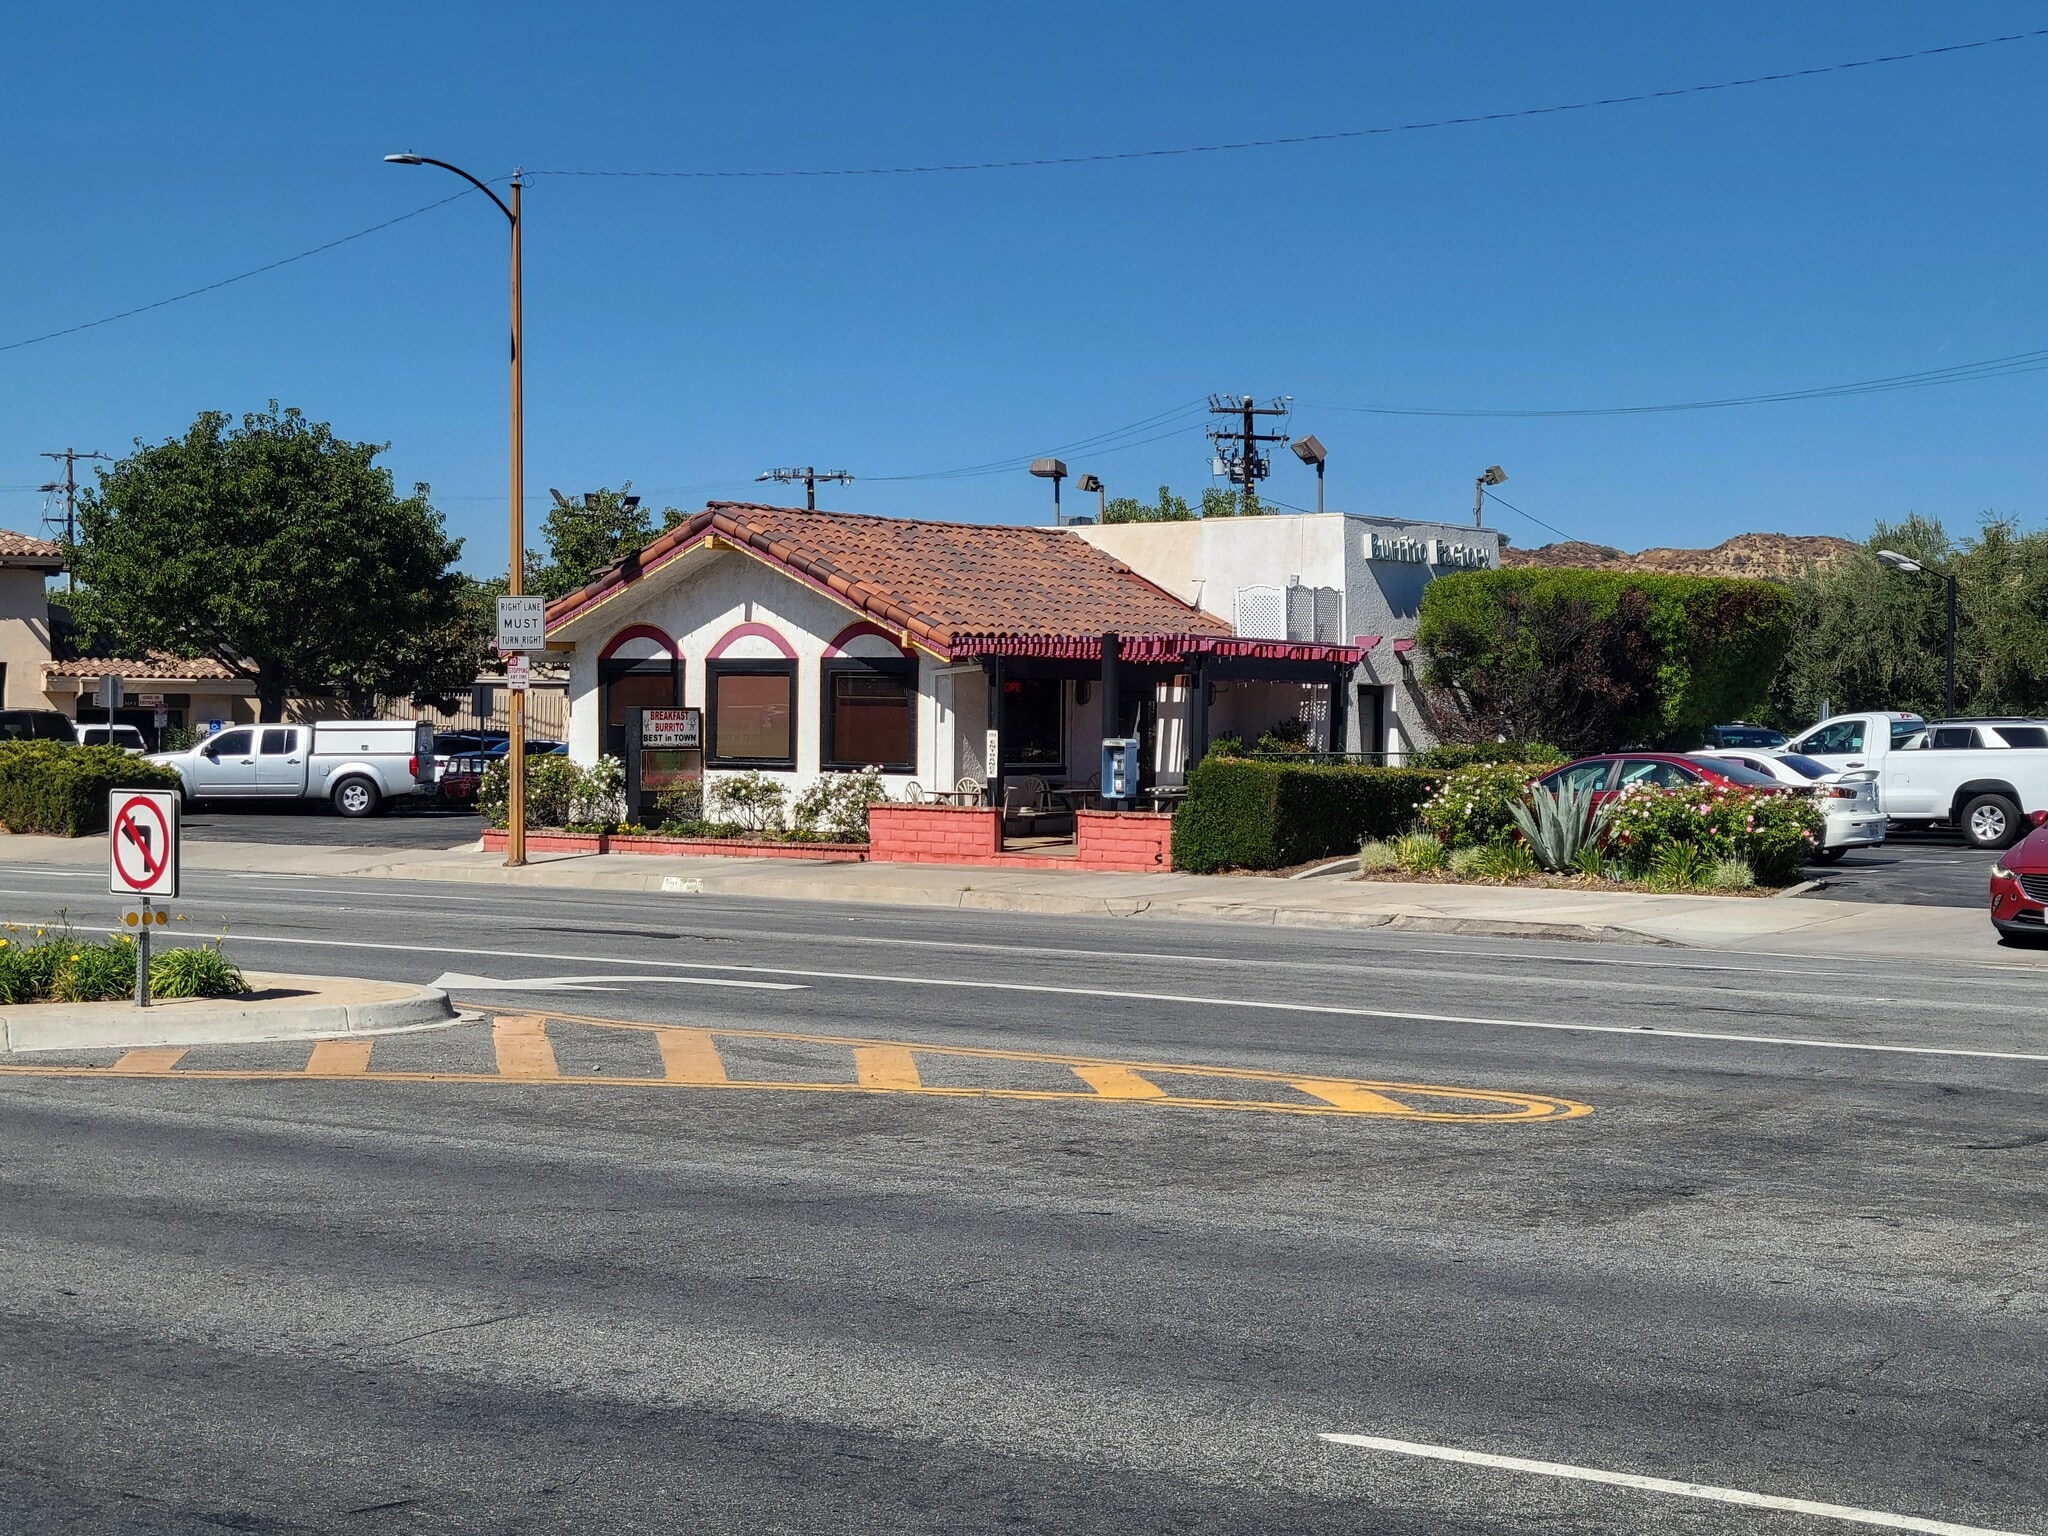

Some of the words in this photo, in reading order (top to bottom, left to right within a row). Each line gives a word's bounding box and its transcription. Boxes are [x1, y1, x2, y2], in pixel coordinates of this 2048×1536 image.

[1363, 533, 1428, 563] Burrito
[1429, 539, 1490, 568] Factory
[501, 603, 520, 611] RIGHT
[524, 603, 541, 611] LANE
[504, 619, 538, 628] MUST
[502, 636, 519, 644] TURN
[522, 636, 542, 644] RIGHT
[650, 711, 689, 720] BREAKFAST
[655, 722, 684, 732] BURRITO
